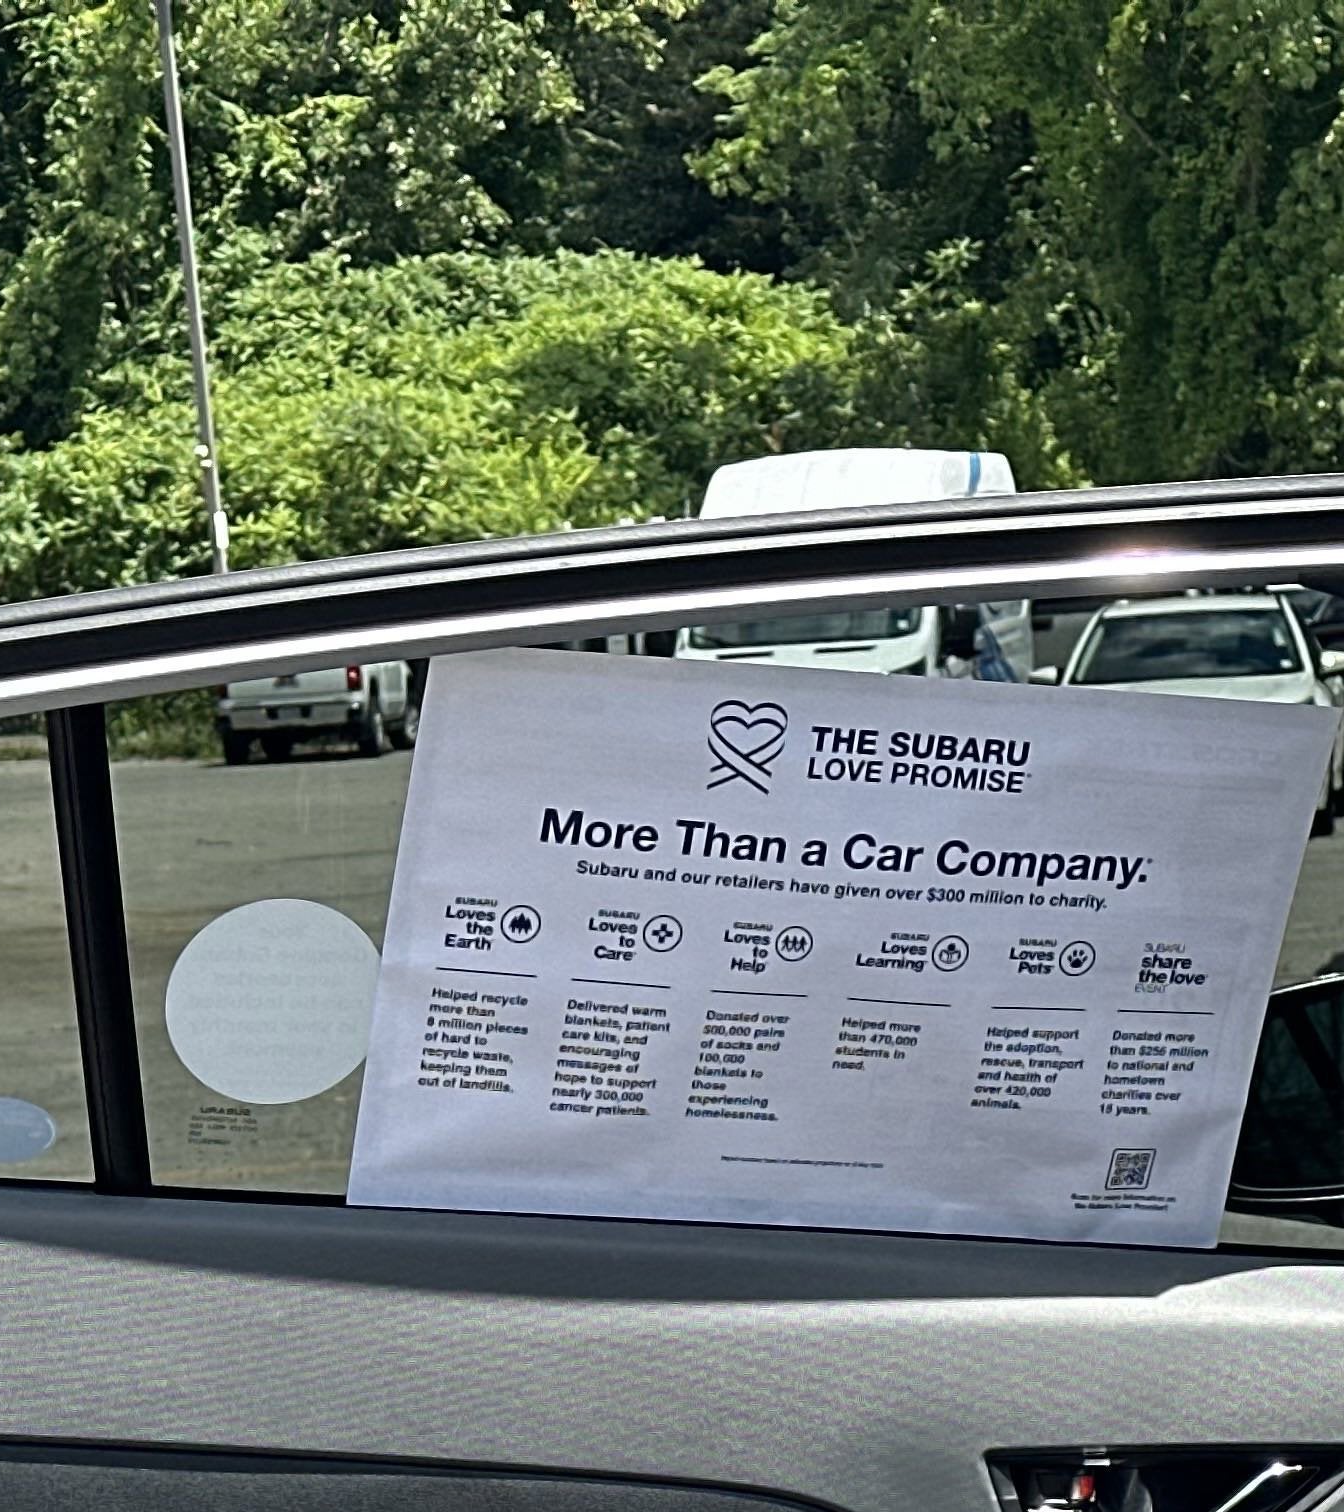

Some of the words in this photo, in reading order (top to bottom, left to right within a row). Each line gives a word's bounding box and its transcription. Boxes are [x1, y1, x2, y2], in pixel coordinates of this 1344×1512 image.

[810, 726, 880, 756] THE
[887, 731, 1031, 768] SUBARU
[807, 756, 883, 784] LOVE
[890, 762, 1029, 793] PROMISE
[540, 808, 659, 853] More
[674, 819, 787, 865] Than
[800, 839, 829, 868] a
[842, 833, 924, 874] Car
[935, 840, 1150, 890] Company.
[576, 858, 640, 879] Subaru
[643, 866, 677, 884] and
[681, 872, 710, 886] our
[715, 871, 785, 893] retailers
[788, 878, 831, 895] have
[833, 882, 880, 900] given
[885, 885, 923, 900] over
[925, 885, 965, 903] $300
[968, 888, 1024, 905] million
[1029, 892, 1045, 906] to
[1049, 891, 1107, 912] charity.
[455, 897, 498, 908] SUBARU
[445, 905, 497, 922] Loves
[598, 909, 641, 921] SUBARU
[466, 920, 495, 937] the
[588, 917, 638, 935] Loves
[733, 922, 775, 932] SUBARU
[444, 932, 493, 951] Earth
[618, 934, 636, 948] to
[724, 929, 771, 947] Loves
[890, 931, 931, 942] SUBARU
[1019, 938, 1058, 947] SUBARU
[594, 945, 635, 962] Care
[752, 946, 769, 960] to
[880, 941, 928, 957] Loves
[1008, 946, 1055, 962] Loves
[730, 957, 767, 974] Help
[855, 953, 926, 973] Learning
[1017, 960, 1055, 975] Pets
[1141, 953, 1192, 970] share
[1137, 968, 1168, 984] the
[1168, 969, 1206, 986] love
[431, 987, 478, 1003] Helped
[481, 994, 528, 1007] recycle
[429, 1003, 464, 1015] more
[465, 1005, 495, 1017] than
[567, 999, 629, 1016] Delivered
[632, 1004, 666, 1017] warm
[564, 1013, 623, 1031] blankets,
[625, 1021, 671, 1033] patient
[705, 1009, 760, 1023] Donated
[762, 1015, 790, 1024] over
[842, 1016, 887, 1032] Helped
[889, 1023, 921, 1033] more
[438, 1018, 482, 1032] million
[485, 1021, 528, 1035] pieces
[753, 1027, 785, 1039] pairs
[424, 1030, 439, 1043] of
[440, 1032, 471, 1046] hard
[474, 1034, 488, 1047] to
[562, 1030, 591, 1041] care
[623, 1035, 648, 1045] and
[700, 1038, 714, 1049] of
[716, 1040, 754, 1051] socks
[756, 1041, 781, 1051] and
[839, 1031, 866, 1043] than
[559, 1045, 640, 1062] encouraging
[835, 1046, 890, 1059] students
[893, 1049, 905, 1059] in
[420, 1059, 472, 1077] keeping
[475, 1064, 507, 1077] them
[557, 1059, 623, 1074] messages
[625, 1062, 640, 1074] of
[694, 1065, 747, 1079] blankets
[751, 1069, 764, 1079] to
[554, 1071, 588, 1086] hope
[590, 1072, 604, 1085] to
[606, 1075, 657, 1090] support
[692, 1080, 727, 1091] those
[552, 1087, 592, 1101] nearly
[594, 1089, 643, 1103] 300,000
[688, 1095, 768, 1109] experiencing
[549, 1102, 594, 1113] cancer
